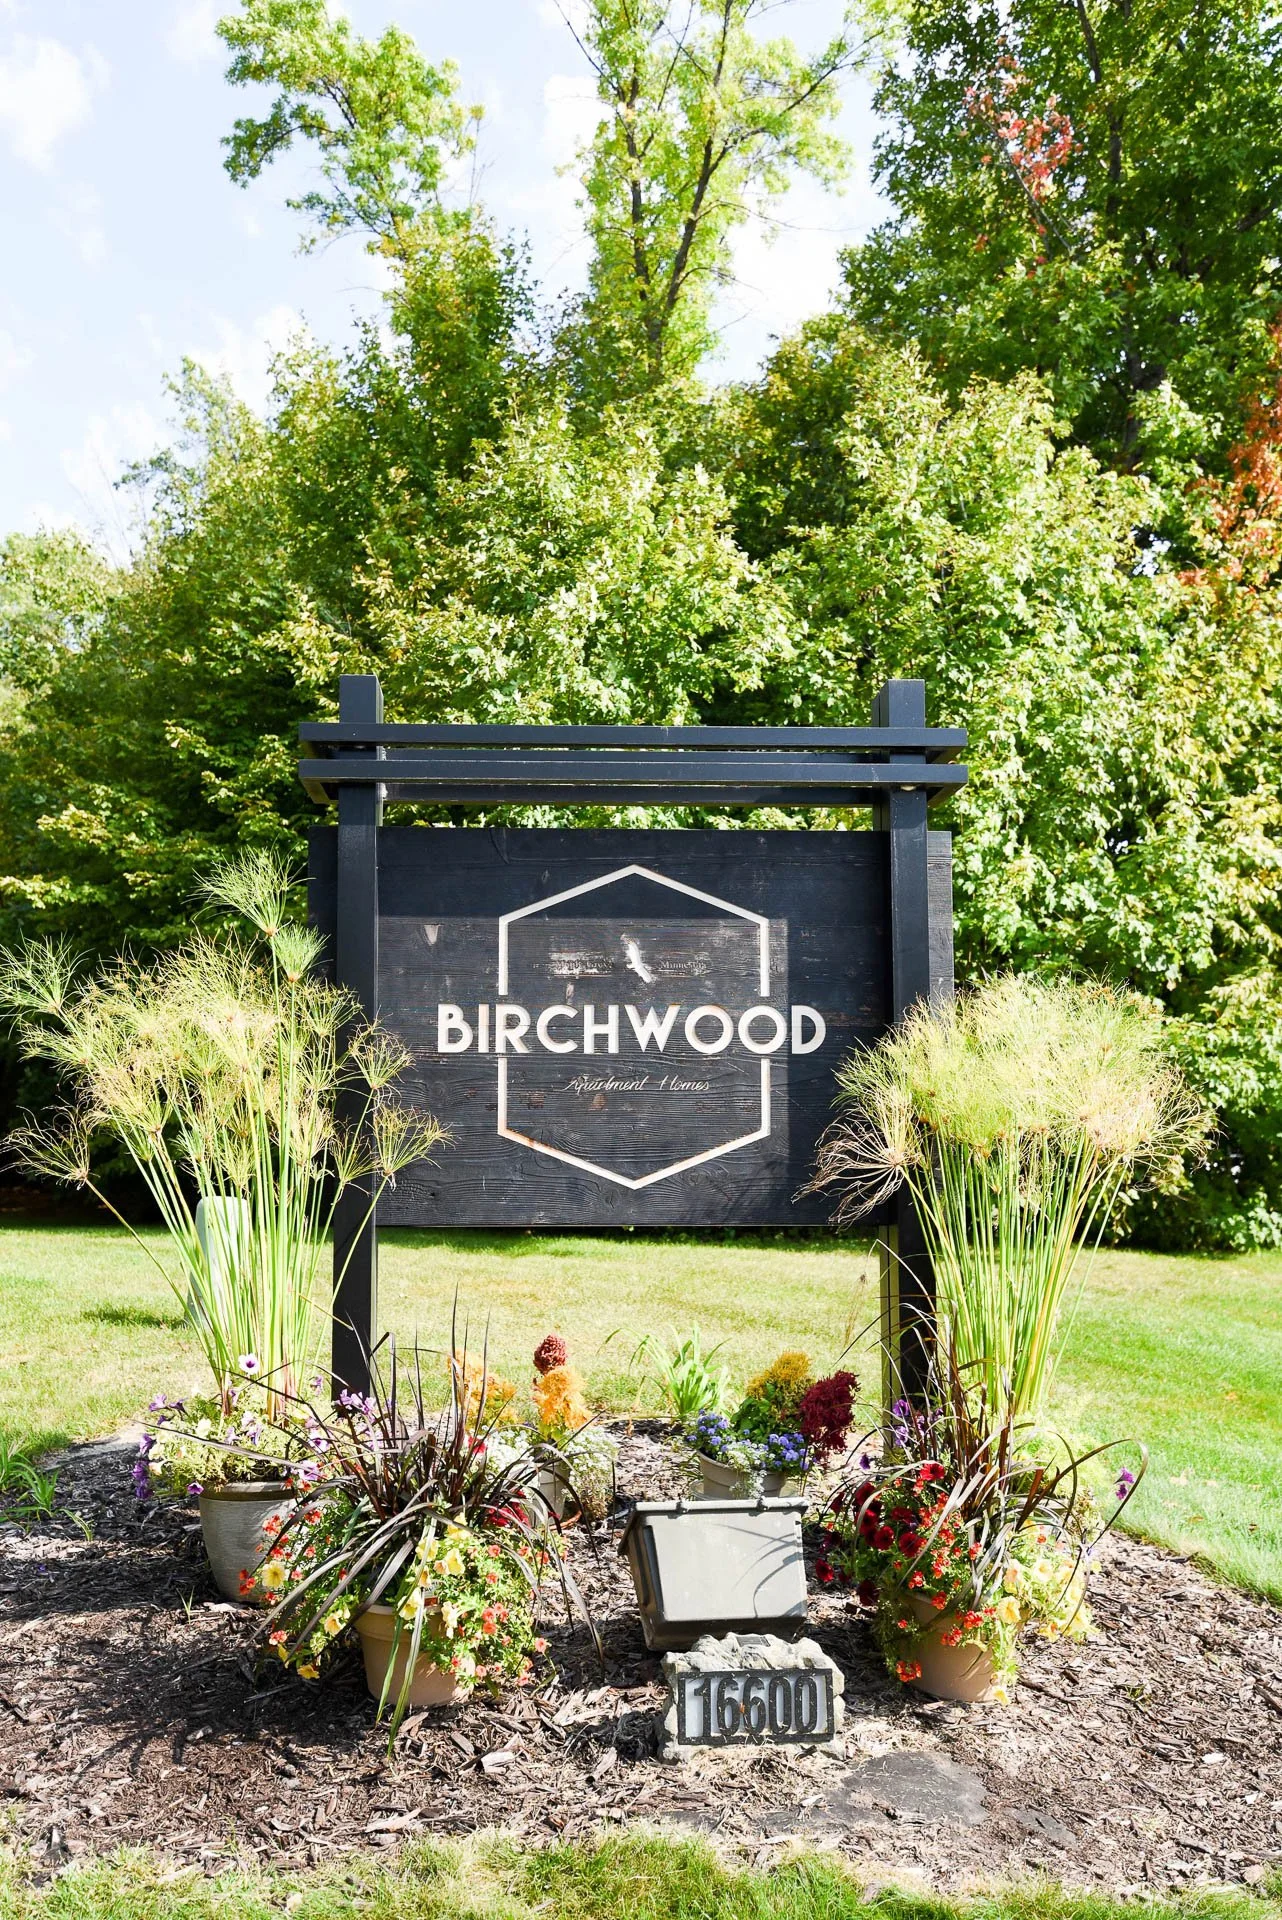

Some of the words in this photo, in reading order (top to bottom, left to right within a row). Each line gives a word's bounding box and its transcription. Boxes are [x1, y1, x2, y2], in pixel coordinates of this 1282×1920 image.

[437, 1003, 827, 1055] BIRCHWOOD
[564, 1075, 648, 1095] Apartment
[659, 1075, 710, 1091] Homes
[693, 1675, 818, 1737] 16600
